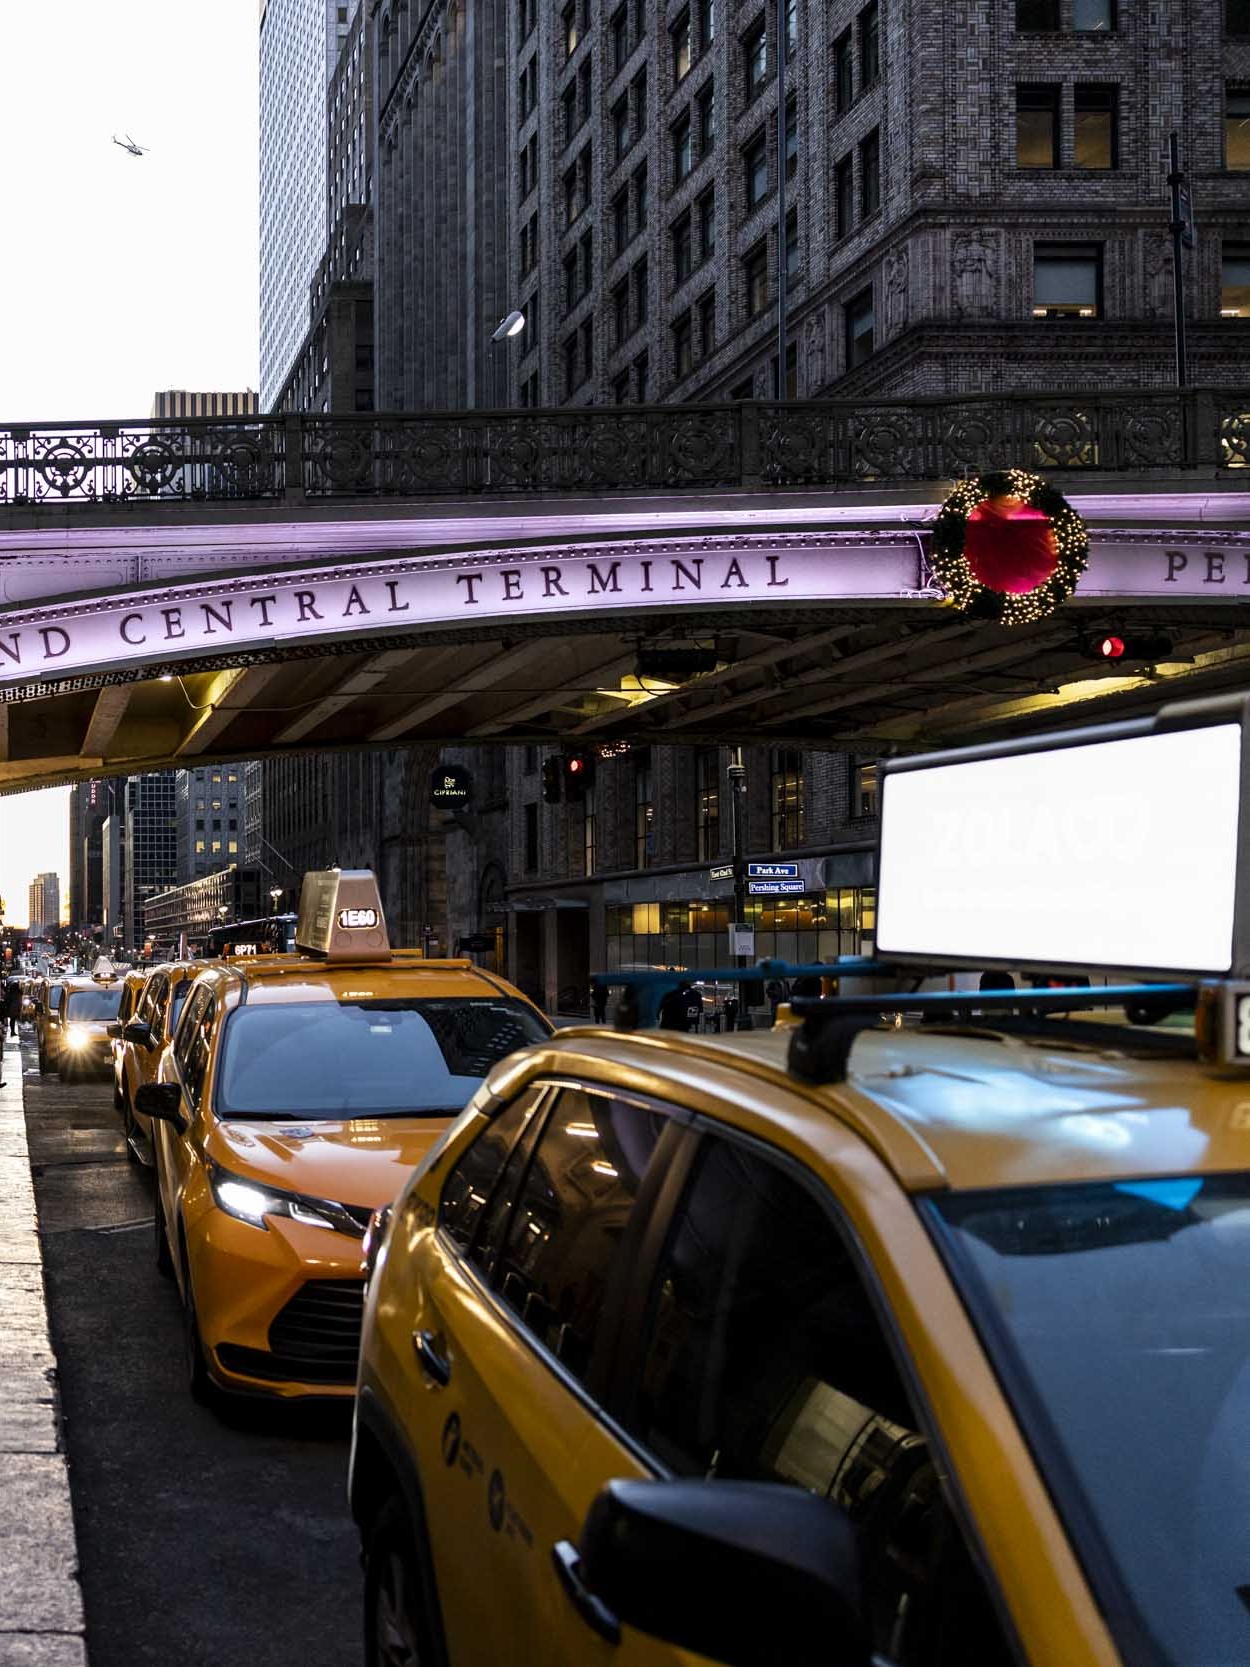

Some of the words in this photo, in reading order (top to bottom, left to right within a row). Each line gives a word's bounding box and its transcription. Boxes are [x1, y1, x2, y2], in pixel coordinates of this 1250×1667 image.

[119, 580, 410, 646] CENTRAL
[455, 555, 790, 604] TERMINAL
[756, 866, 773, 874] Park
[750, 883, 779, 892] Pershing
[780, 883, 803, 892] Square
